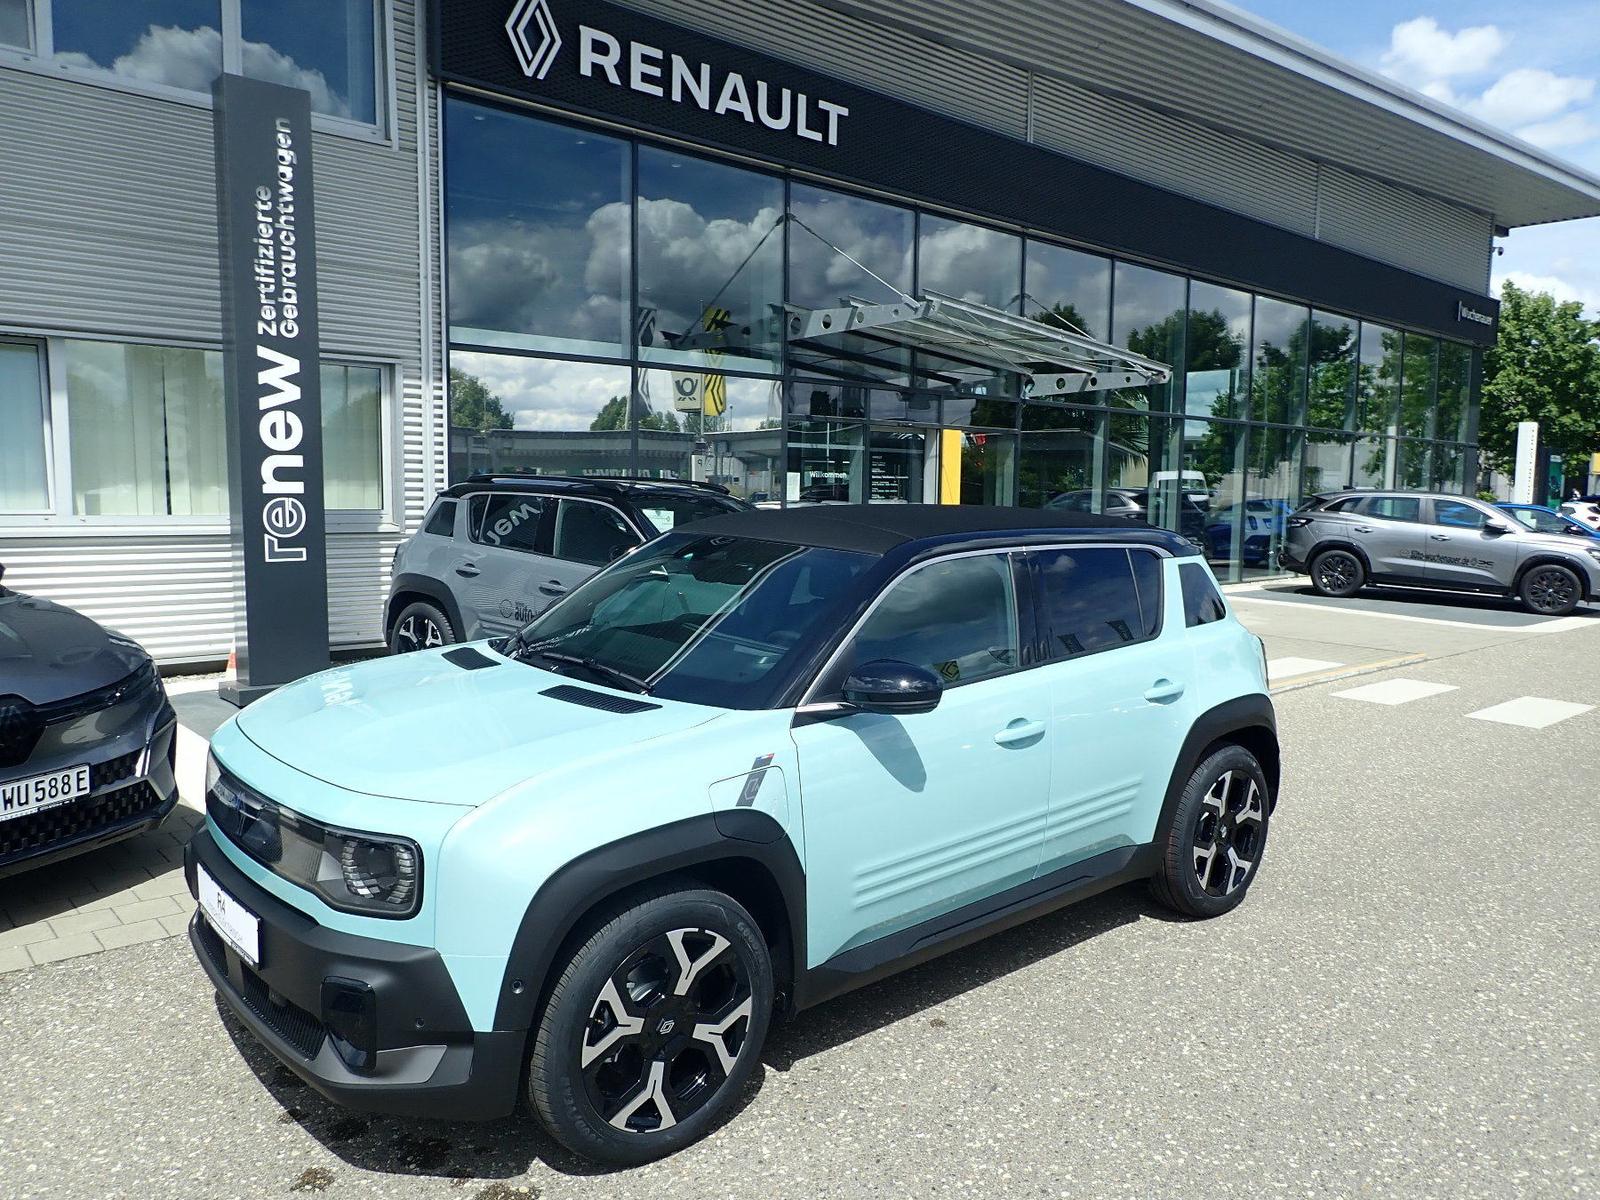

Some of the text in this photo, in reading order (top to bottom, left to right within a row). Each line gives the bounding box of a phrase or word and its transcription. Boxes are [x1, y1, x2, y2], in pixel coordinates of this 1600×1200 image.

[578, 24, 849, 146] RENAULT
[253, 184, 277, 337] Zertifizierte
[274, 117, 299, 339] Gebrauchtwagen
[256, 344, 307, 563] renew
[809, 470, 848, 479] Willkommen
[2, 783, 29, 811] WU
